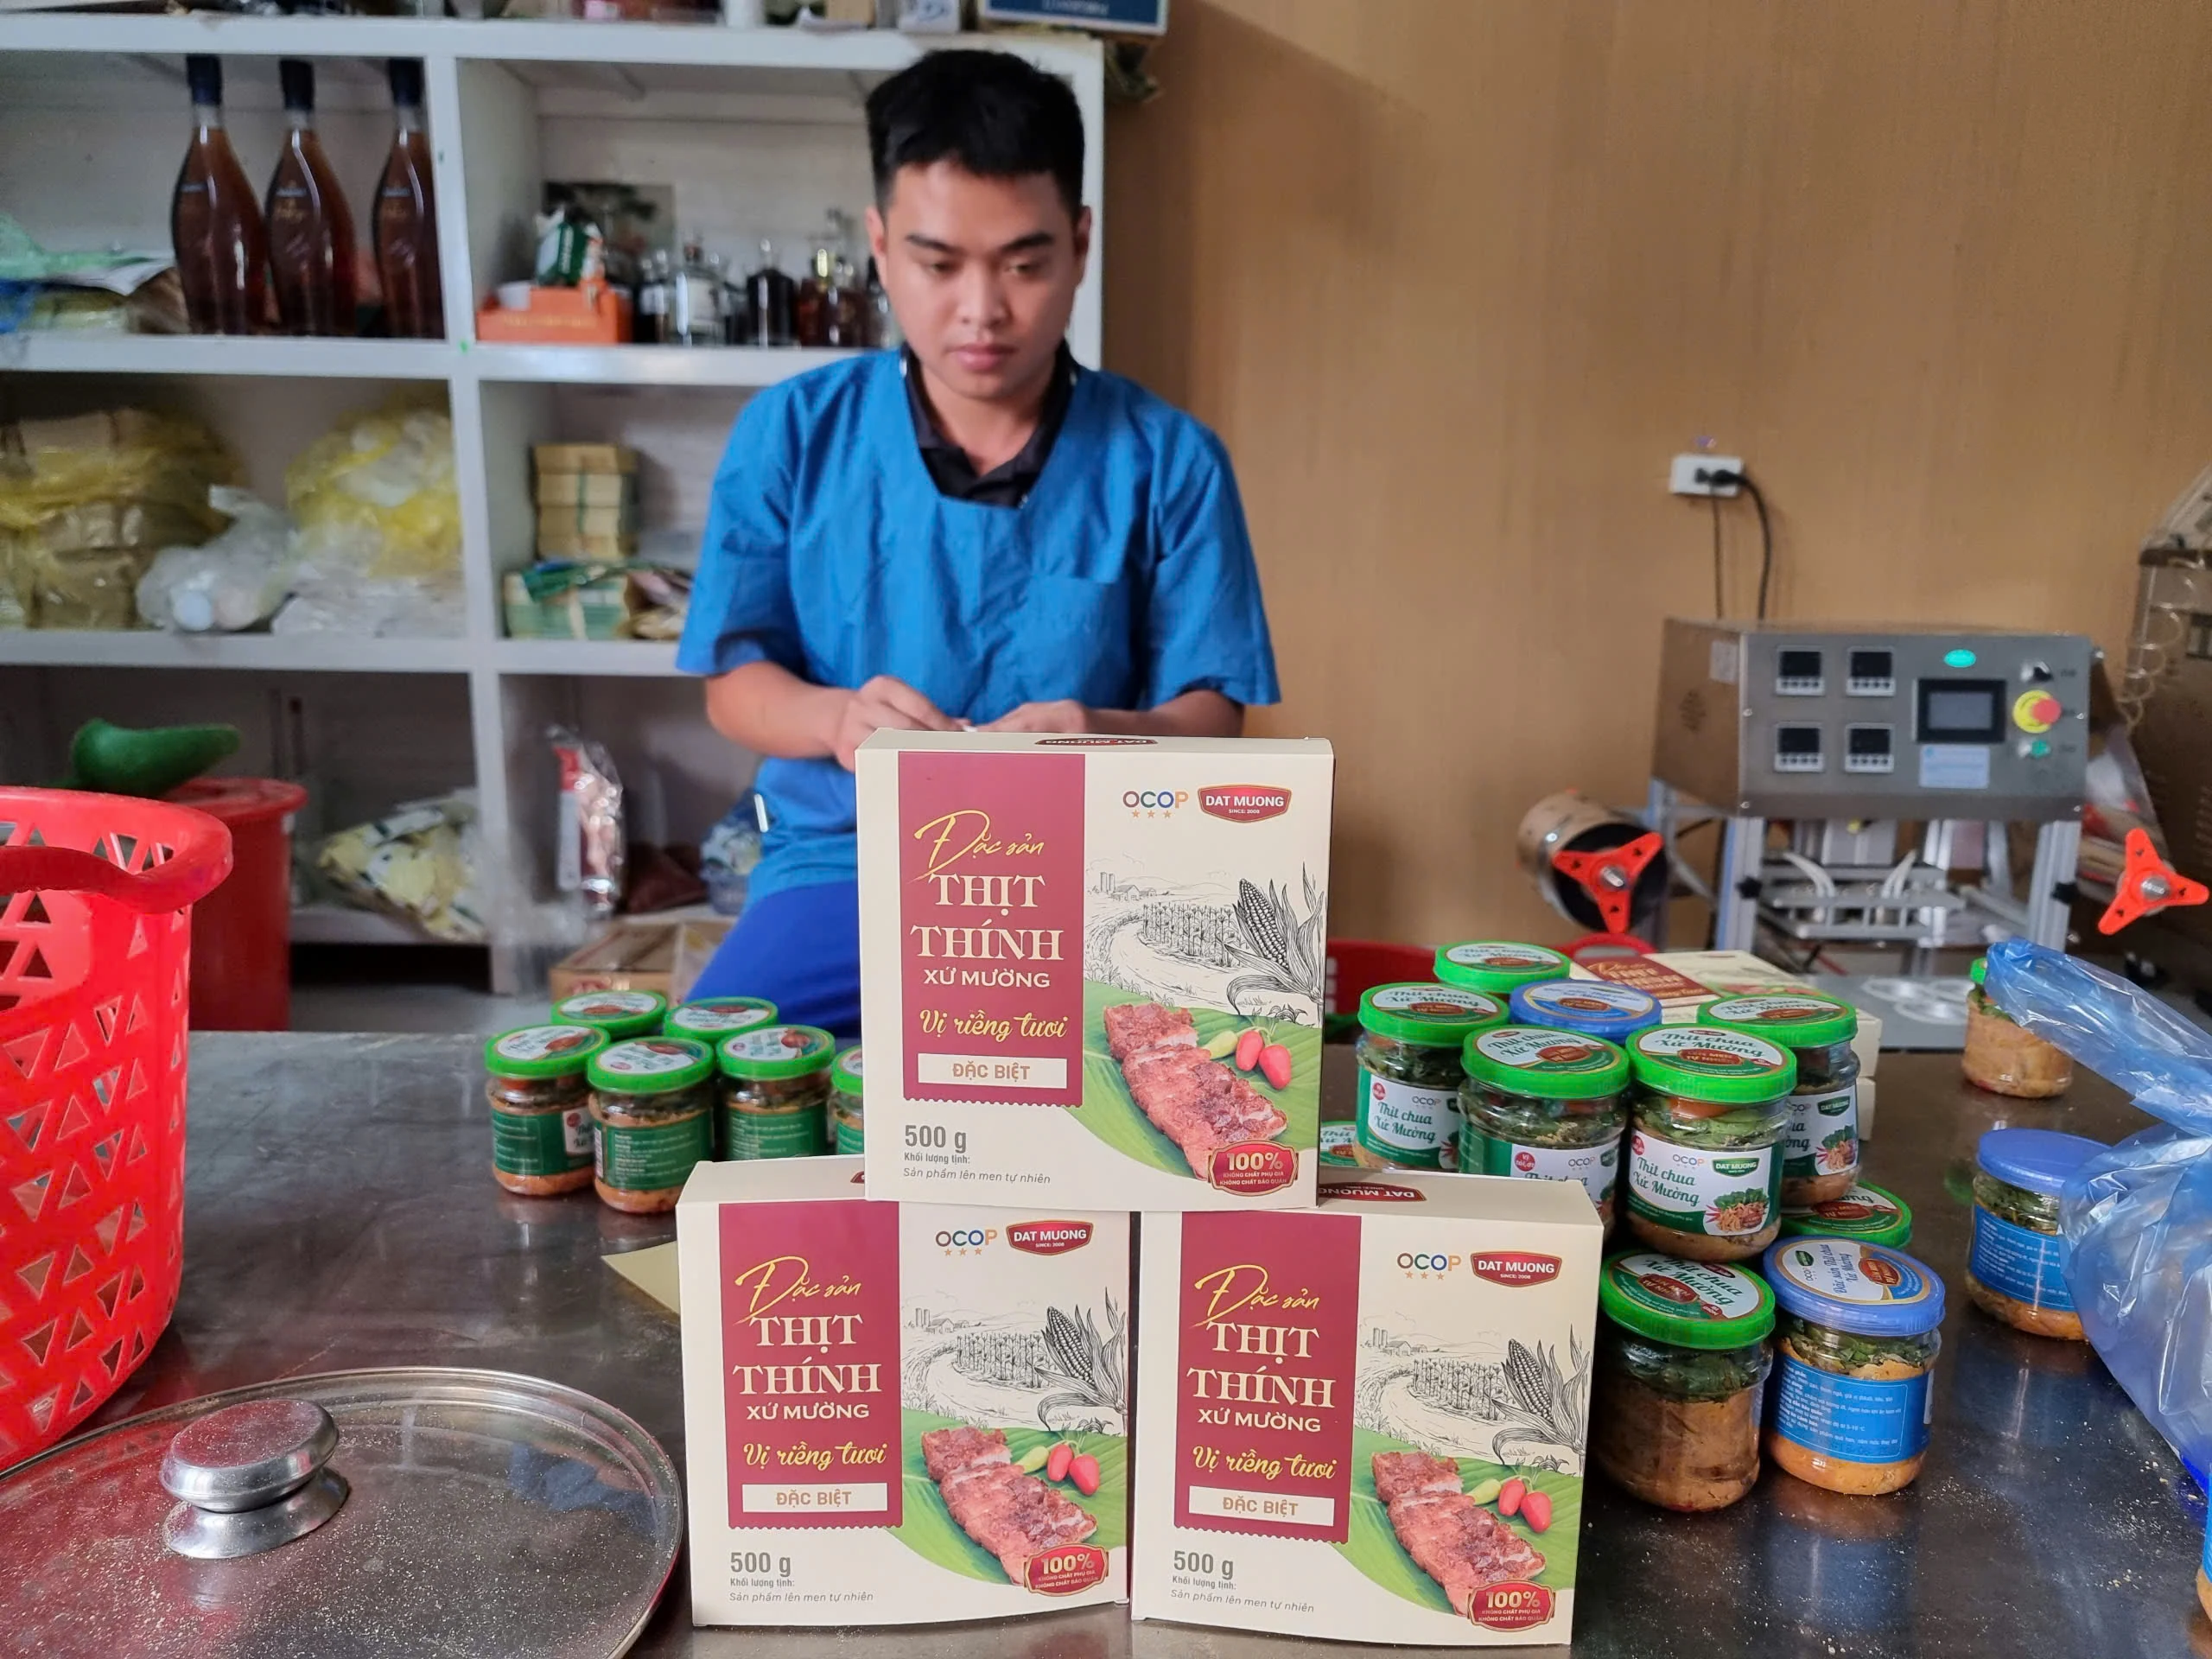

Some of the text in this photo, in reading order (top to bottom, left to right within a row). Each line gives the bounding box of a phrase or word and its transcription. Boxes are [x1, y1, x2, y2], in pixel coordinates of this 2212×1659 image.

[1122, 791, 1189, 809] OCOP
[1205, 795, 1285, 807] DAT MUONG
[907, 809, 1045, 885] Đặc sản
[927, 872, 1046, 916] THỊT
[910, 918, 1065, 961] THÍNH
[923, 966, 1051, 988] XỨ MƯỜNG
[919, 1008, 1069, 1042] Vị riềng tươi
[1691, 1041, 1764, 1058] Mường
[1706, 1035, 1757, 1047] chua
[952, 1060, 1030, 1083] ĐẶC BIỆT
[1377, 1102, 1433, 1125] Thịt chua
[905, 1124, 967, 1154] 500 g
[1374, 1116, 1436, 1145] Xứ Mường
[904, 1152, 924, 1162] Khối
[925, 1154, 949, 1165] lượng
[1227, 1152, 1284, 1171] 100%
[1672, 1154, 1705, 1166] OCOP
[903, 1167, 1051, 1185] Sản phẩm lên men tự nhiên
[1637, 1156, 1696, 1186] Thịt chua
[1633, 1172, 1700, 1207] Xứ Mường
[935, 1229, 998, 1248] OCOP
[1014, 1230, 1087, 1243] DAT MUONG
[1397, 1253, 1461, 1271] OCOP
[1478, 1260, 1554, 1274] DAT MUONG
[733, 1255, 861, 1325] Đặc sản
[1669, 1271, 1735, 1306] Mường
[1696, 1272, 1744, 1296] chua
[1189, 1264, 1320, 1329] Đặc sản
[748, 1313, 863, 1354] THỊT
[1205, 1320, 1320, 1364] THỊT
[733, 1356, 882, 1395] THÍNH
[1186, 1365, 1336, 1408] THÍNH
[746, 1401, 870, 1420] XỨ MƯỜNG
[1198, 1407, 1321, 1433] XỨ MƯỜNG
[743, 1440, 888, 1471] Vị riềng tươi
[1192, 1446, 1338, 1480] Vị riềng tươi
[776, 1488, 852, 1508] ĐẶC BIỆT
[1223, 1496, 1299, 1518] ĐẶC BIỆT
[730, 1552, 791, 1578] 500 g
[1041, 1553, 1096, 1575] 100%
[1173, 1550, 1234, 1580] 500 g
[730, 1578, 748, 1587] Khối
[1172, 1575, 1191, 1585] Khối
[1192, 1578, 1216, 1590] lượng
[729, 1592, 749, 1601] Sản
[752, 1592, 782, 1603] phẩm
[785, 1592, 801, 1602] lên
[830, 1592, 842, 1603] tự
[843, 1591, 874, 1602] nhiên
[1170, 1589, 1191, 1599] Sản
[1192, 1592, 1223, 1603] phẩm
[1225, 1595, 1242, 1605] lên
[1270, 1599, 1282, 1610] tự
[1284, 1602, 1314, 1613] nhiên
[1486, 1591, 1541, 1608] 100%
